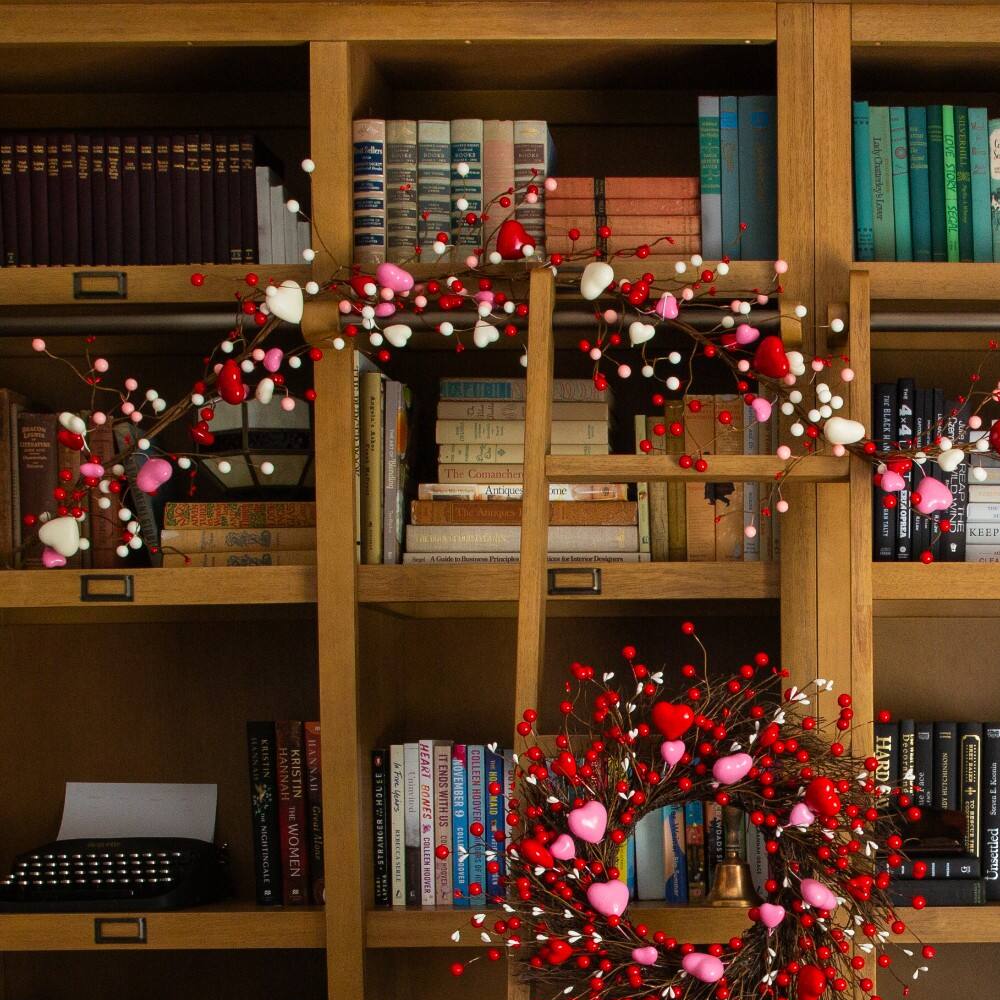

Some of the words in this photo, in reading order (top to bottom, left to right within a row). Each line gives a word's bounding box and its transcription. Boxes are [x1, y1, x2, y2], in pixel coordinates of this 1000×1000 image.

[872, 137, 882, 156] Lady
[945, 134, 954, 157] LOVE
[958, 114, 967, 166] SILVERHILL
[873, 157, 884, 199] Chatterley's
[946, 164, 956, 192] STORY
[876, 199, 884, 220] Lover
[947, 205, 958, 232] SEGAL
[883, 408, 891, 433] BLACK
[386, 459, 397, 489] Blending
[444, 468, 464, 479] The
[957, 463, 966, 501] REAP
[486, 486, 526, 497] Antiques
[900, 508, 908, 538] OPREA
[950, 496, 958, 533] WIND
[957, 505, 966, 533] THE
[970, 528, 999, 537] KEEP
[260, 739, 270, 779] KRISTIN
[308, 739, 318, 792] HANNAH
[420, 744, 431, 779] HEART
[471, 750, 481, 786] COLLEEN
[876, 735, 892, 781] HARD
[280, 747, 290, 801] HANNAH
[291, 749, 301, 798] KRISTIN
[439, 765, 448, 789] ENDS
[453, 759, 464, 807] NOVEMBER
[288, 807, 296, 821] THE
[392, 790, 401, 813] Years
[422, 784, 432, 820] BONES
[440, 791, 449, 813] WITH
[472, 789, 482, 823] HOOVER
[440, 815, 449, 827] US
[260, 826, 270, 884] NIGHTINGALE
[288, 823, 300, 878] WOMEN
[985, 829, 1000, 881] Unsettled
[423, 867, 431, 894] HOOVER
